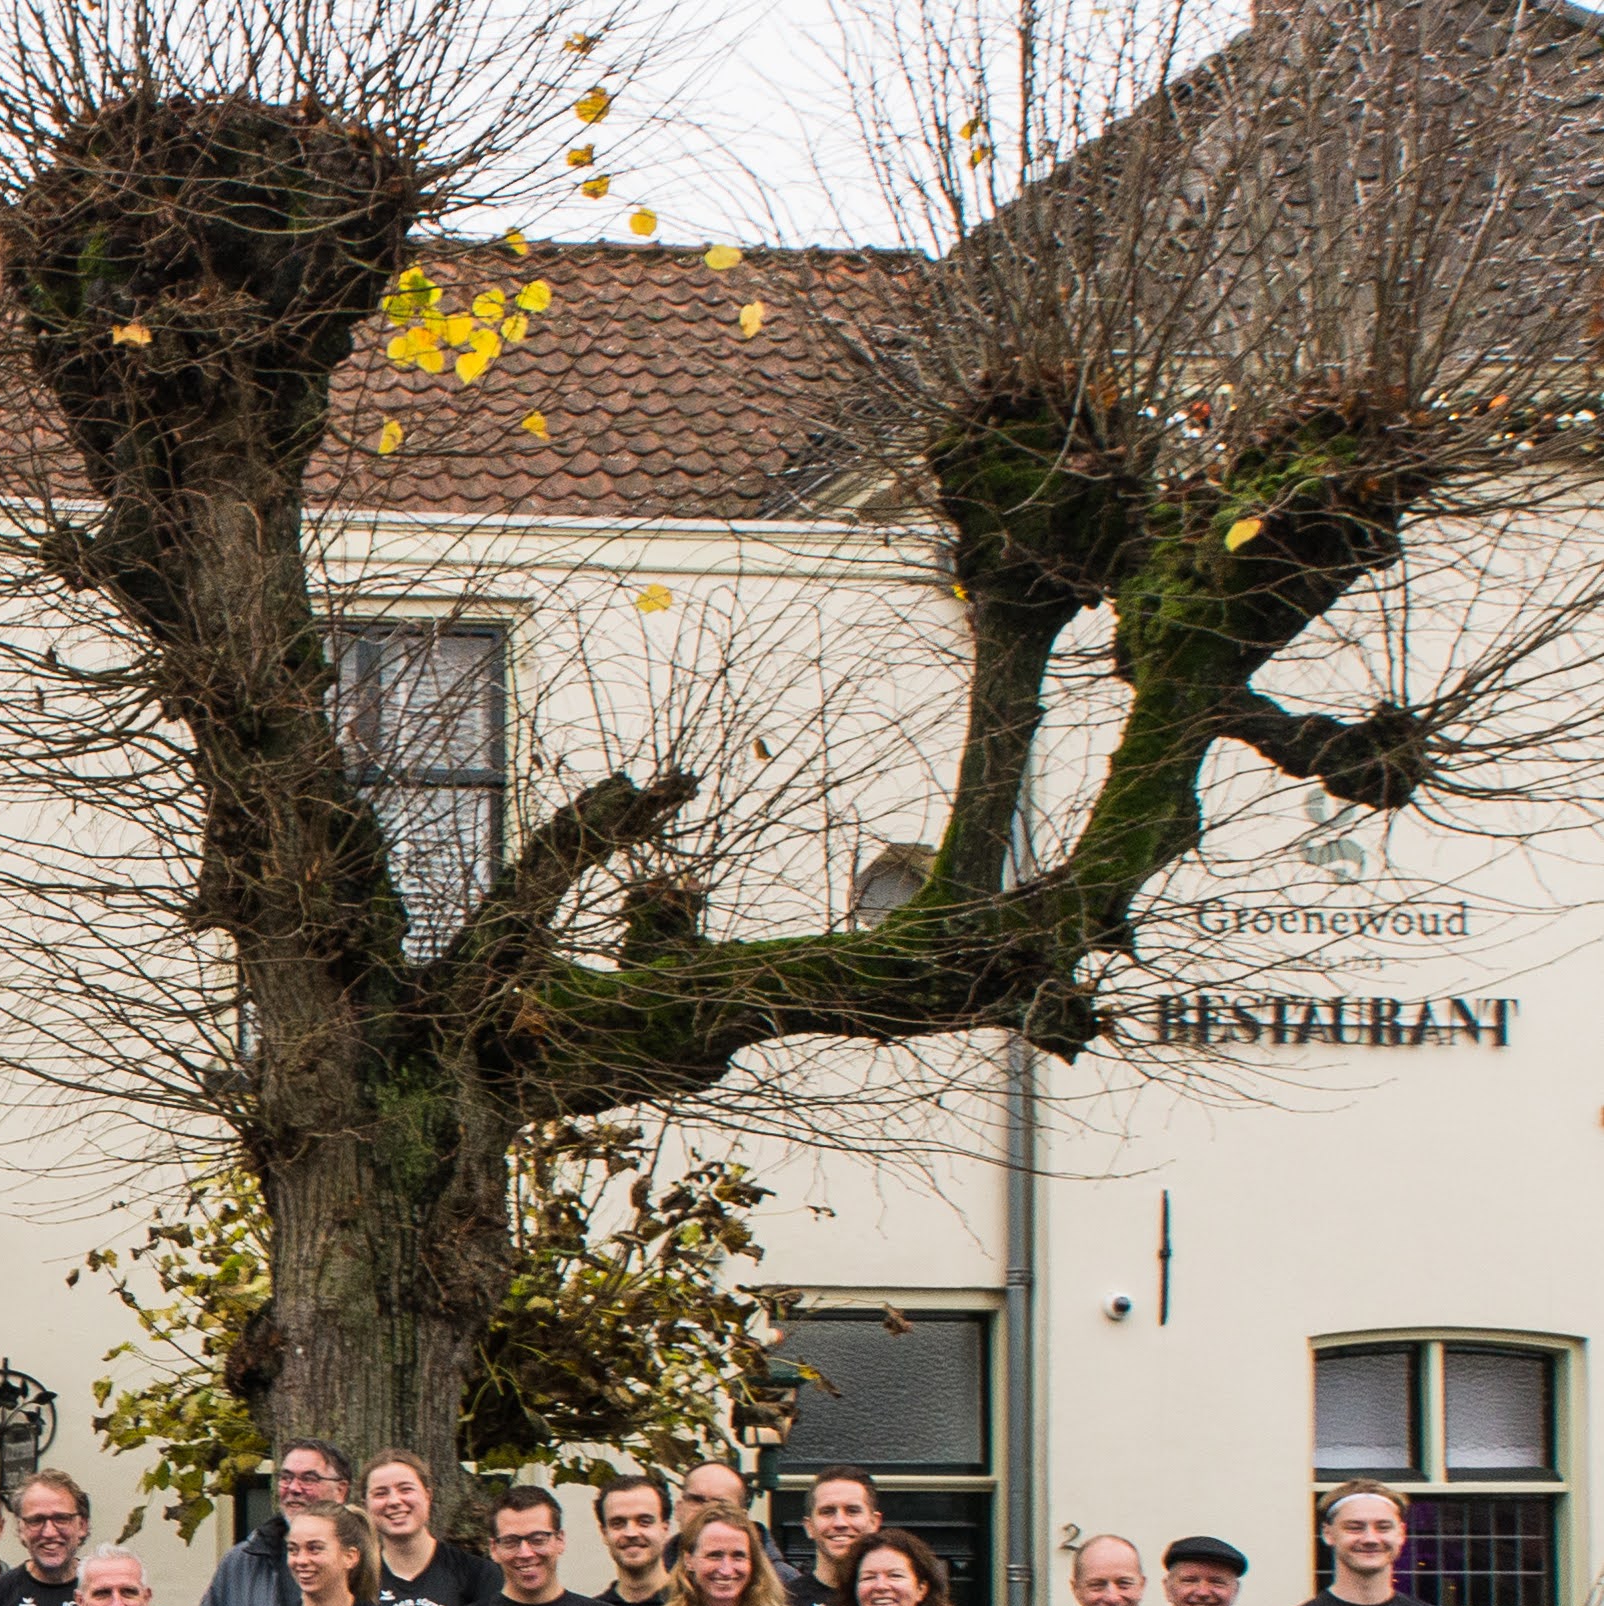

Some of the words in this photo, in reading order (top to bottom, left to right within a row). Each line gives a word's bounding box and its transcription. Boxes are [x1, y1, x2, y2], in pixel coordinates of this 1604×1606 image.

[1195, 899, 1470, 937] Groenewoud
[1157, 993, 1520, 1047] RESTAURANT
[1059, 1523, 1082, 1552] 2
